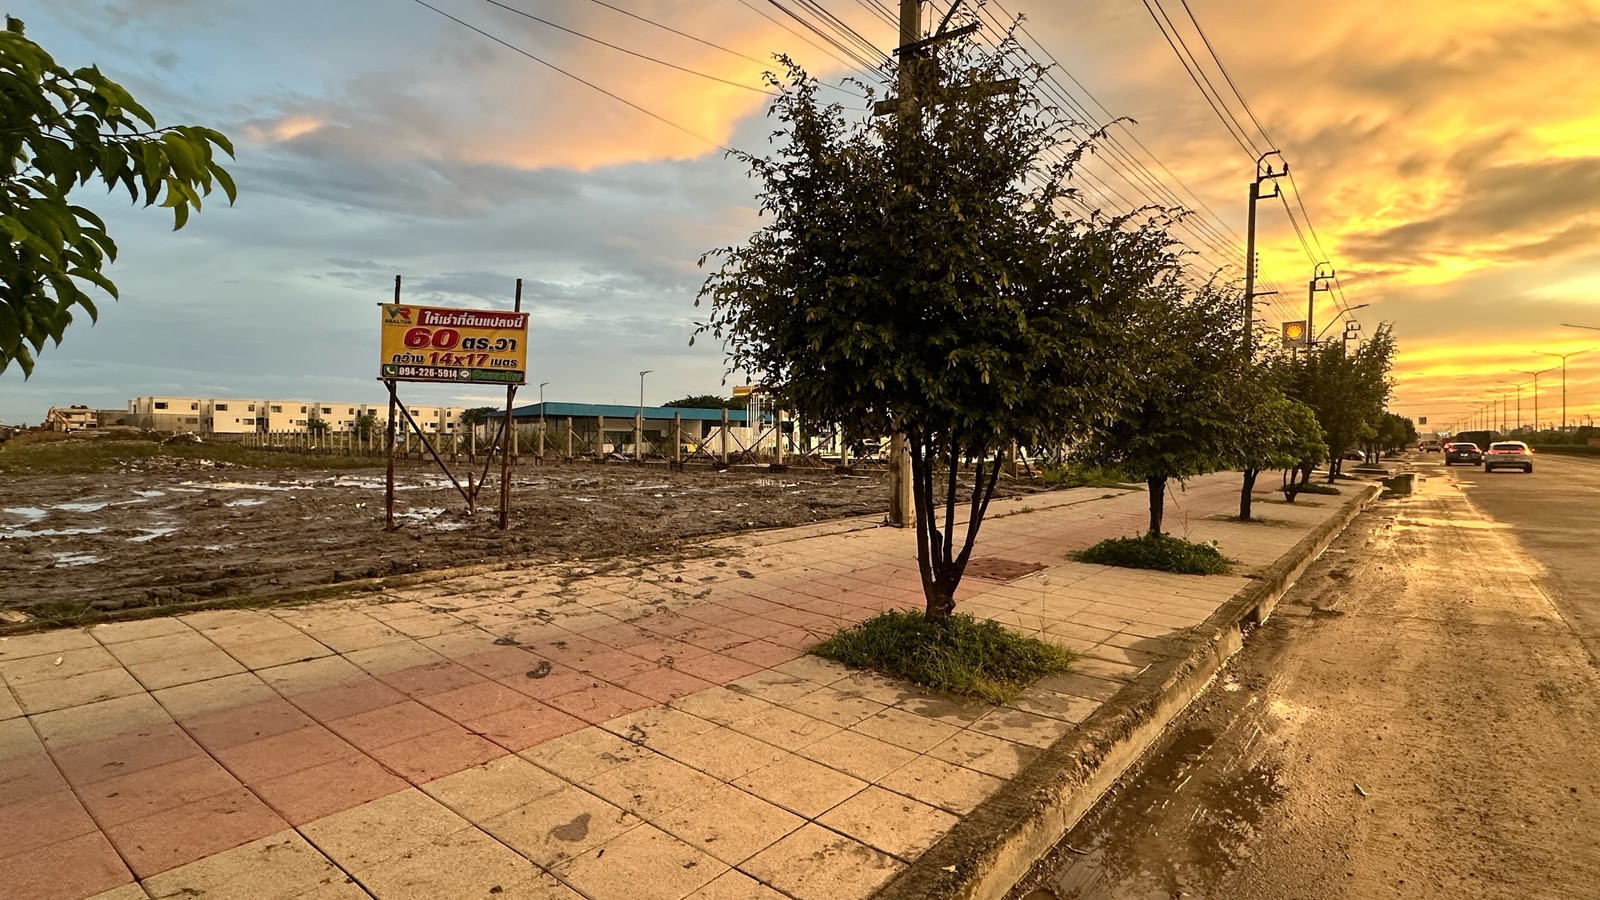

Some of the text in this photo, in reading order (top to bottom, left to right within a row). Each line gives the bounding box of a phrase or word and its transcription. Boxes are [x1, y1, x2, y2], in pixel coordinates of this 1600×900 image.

[424, 311, 524, 328] ให้เช่าที่ดินแปลงนี้
[403, 327, 517, 351] 60 ตร.วา
[392, 352, 518, 367] กว้าง 14x17 เมตร
[399, 367, 457, 378] 094-226-5914
